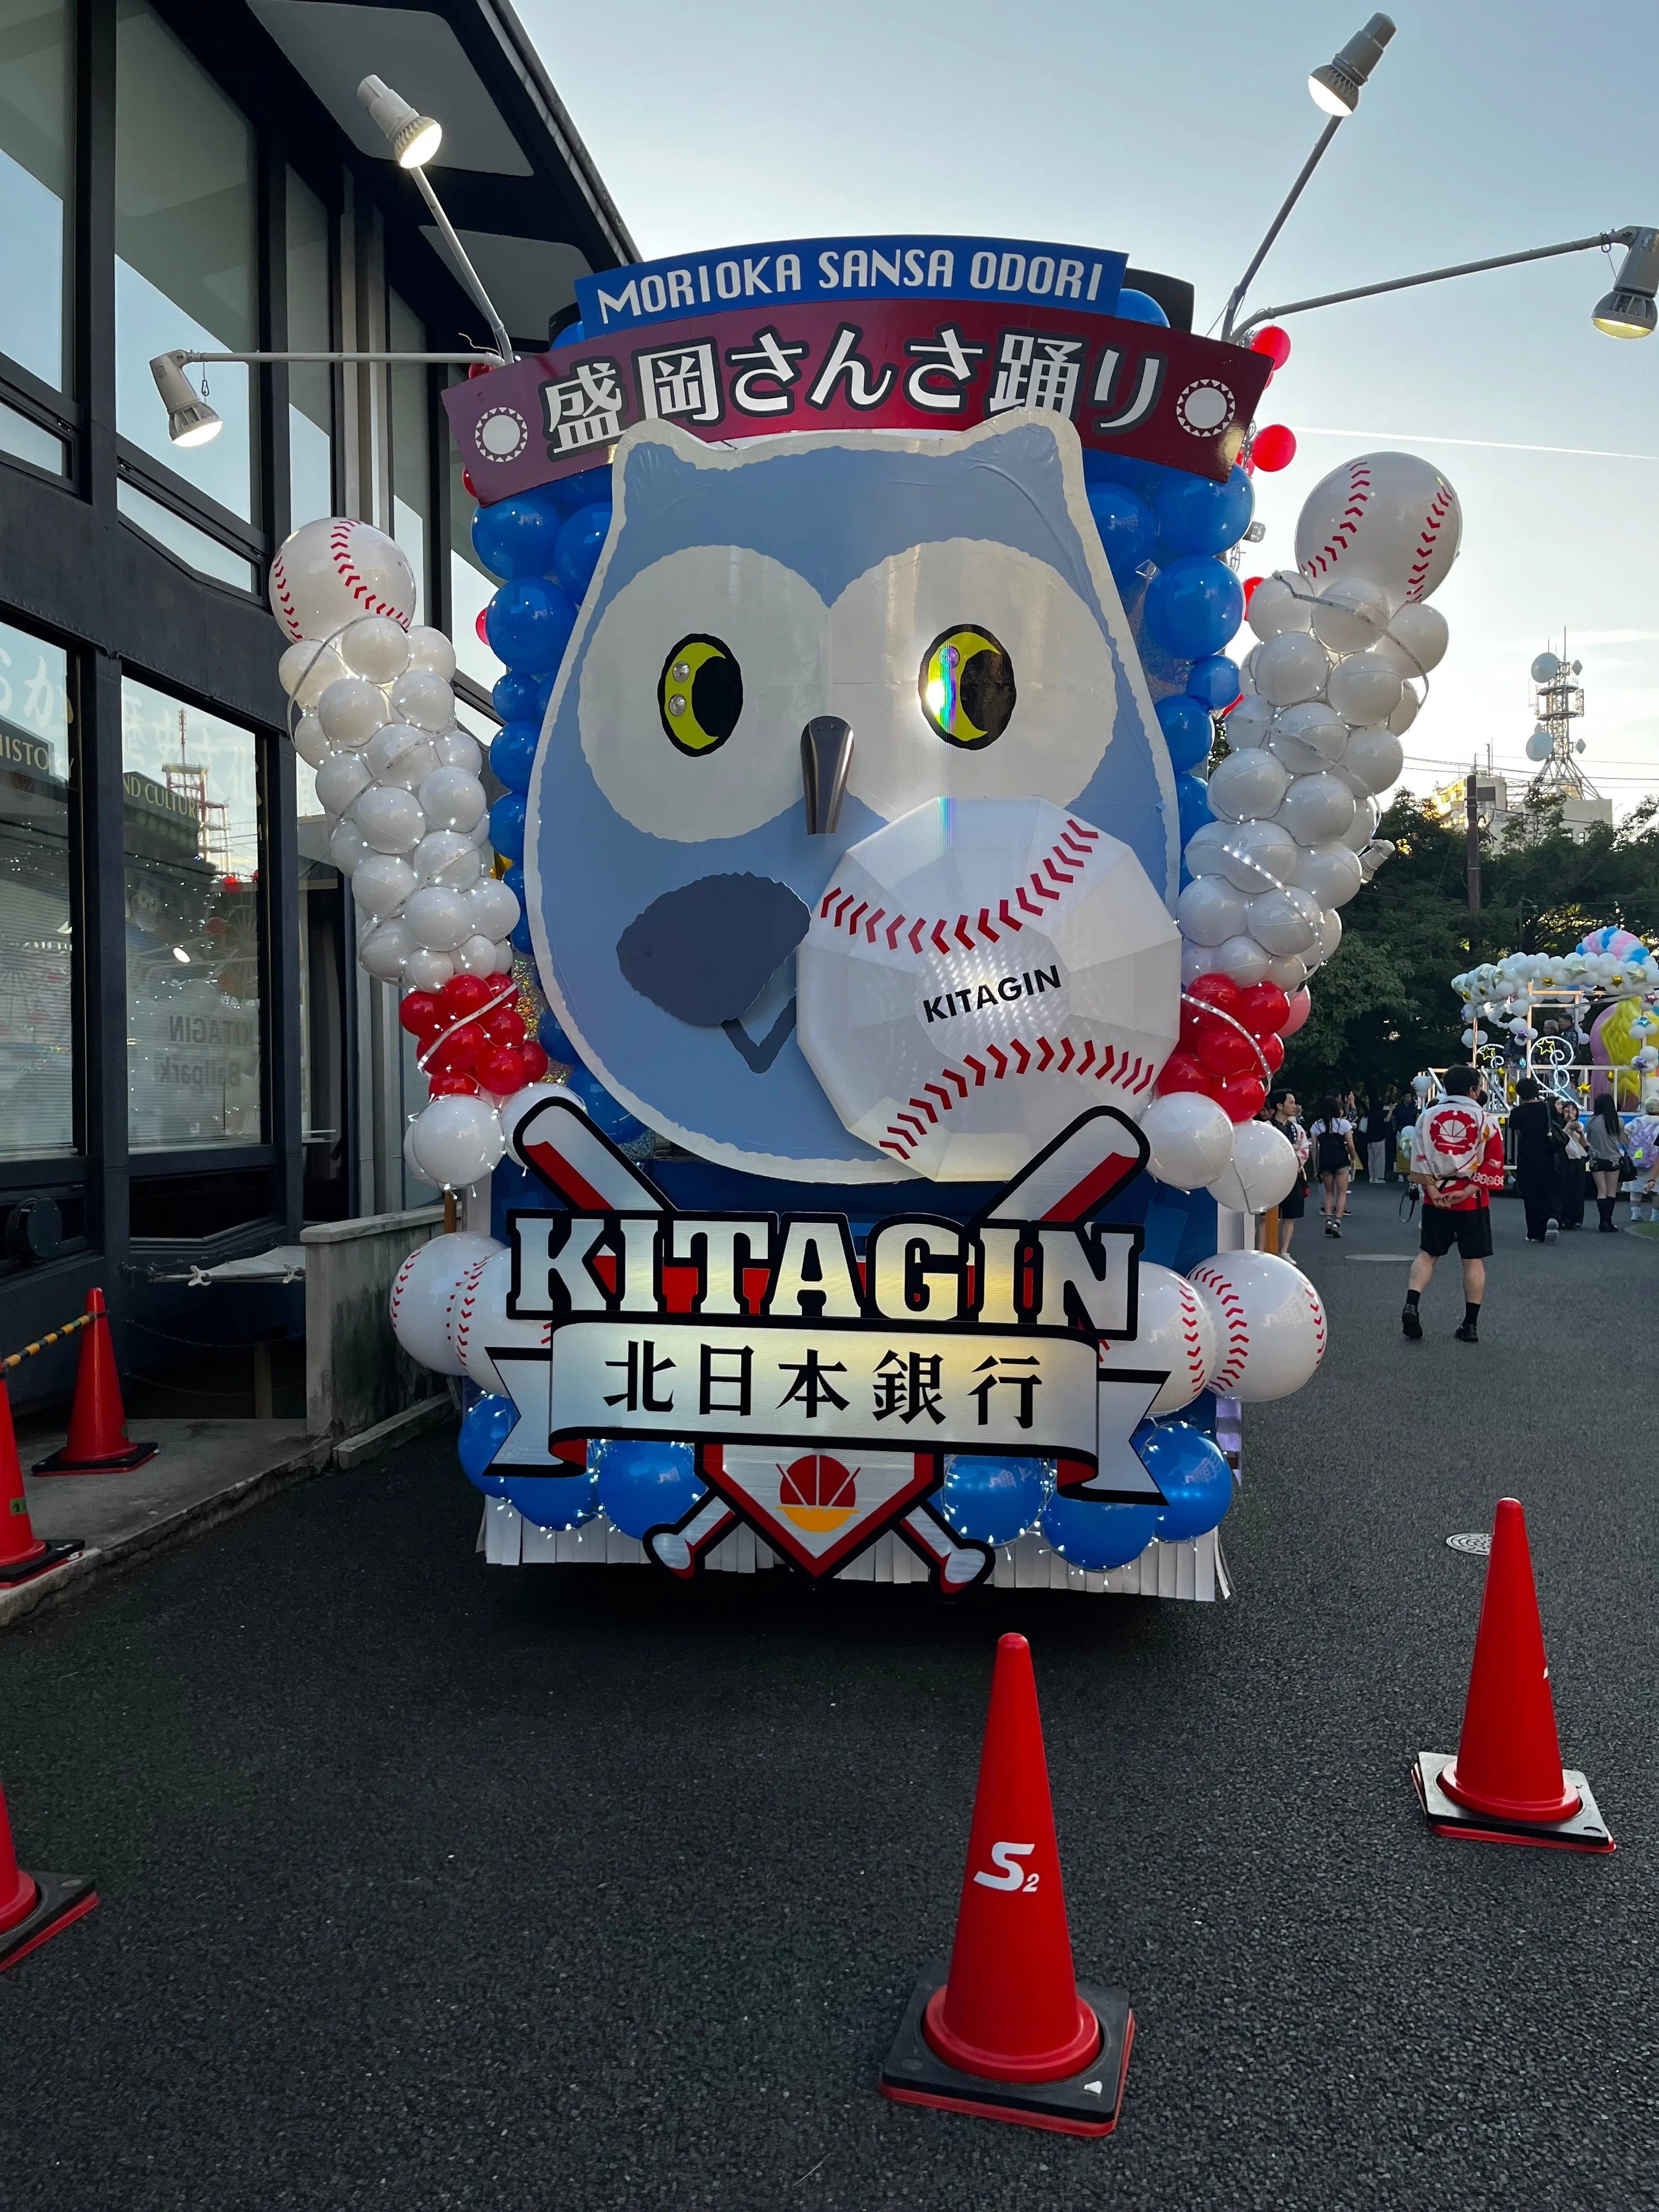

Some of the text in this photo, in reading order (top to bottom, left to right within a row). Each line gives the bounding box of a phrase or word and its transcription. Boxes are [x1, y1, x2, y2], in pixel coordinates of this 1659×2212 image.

[597, 249, 1103, 324] MORIOKA SANSA ODORI
[544, 328, 1161, 454] 盛岡さんさ踊り
[0, 733, 75, 778] ISTORY
[922, 964, 1062, 1023] KITAGIN
[513, 1216, 1139, 1332] KITAGIN
[603, 1339, 1043, 1429] 北日本銀行
